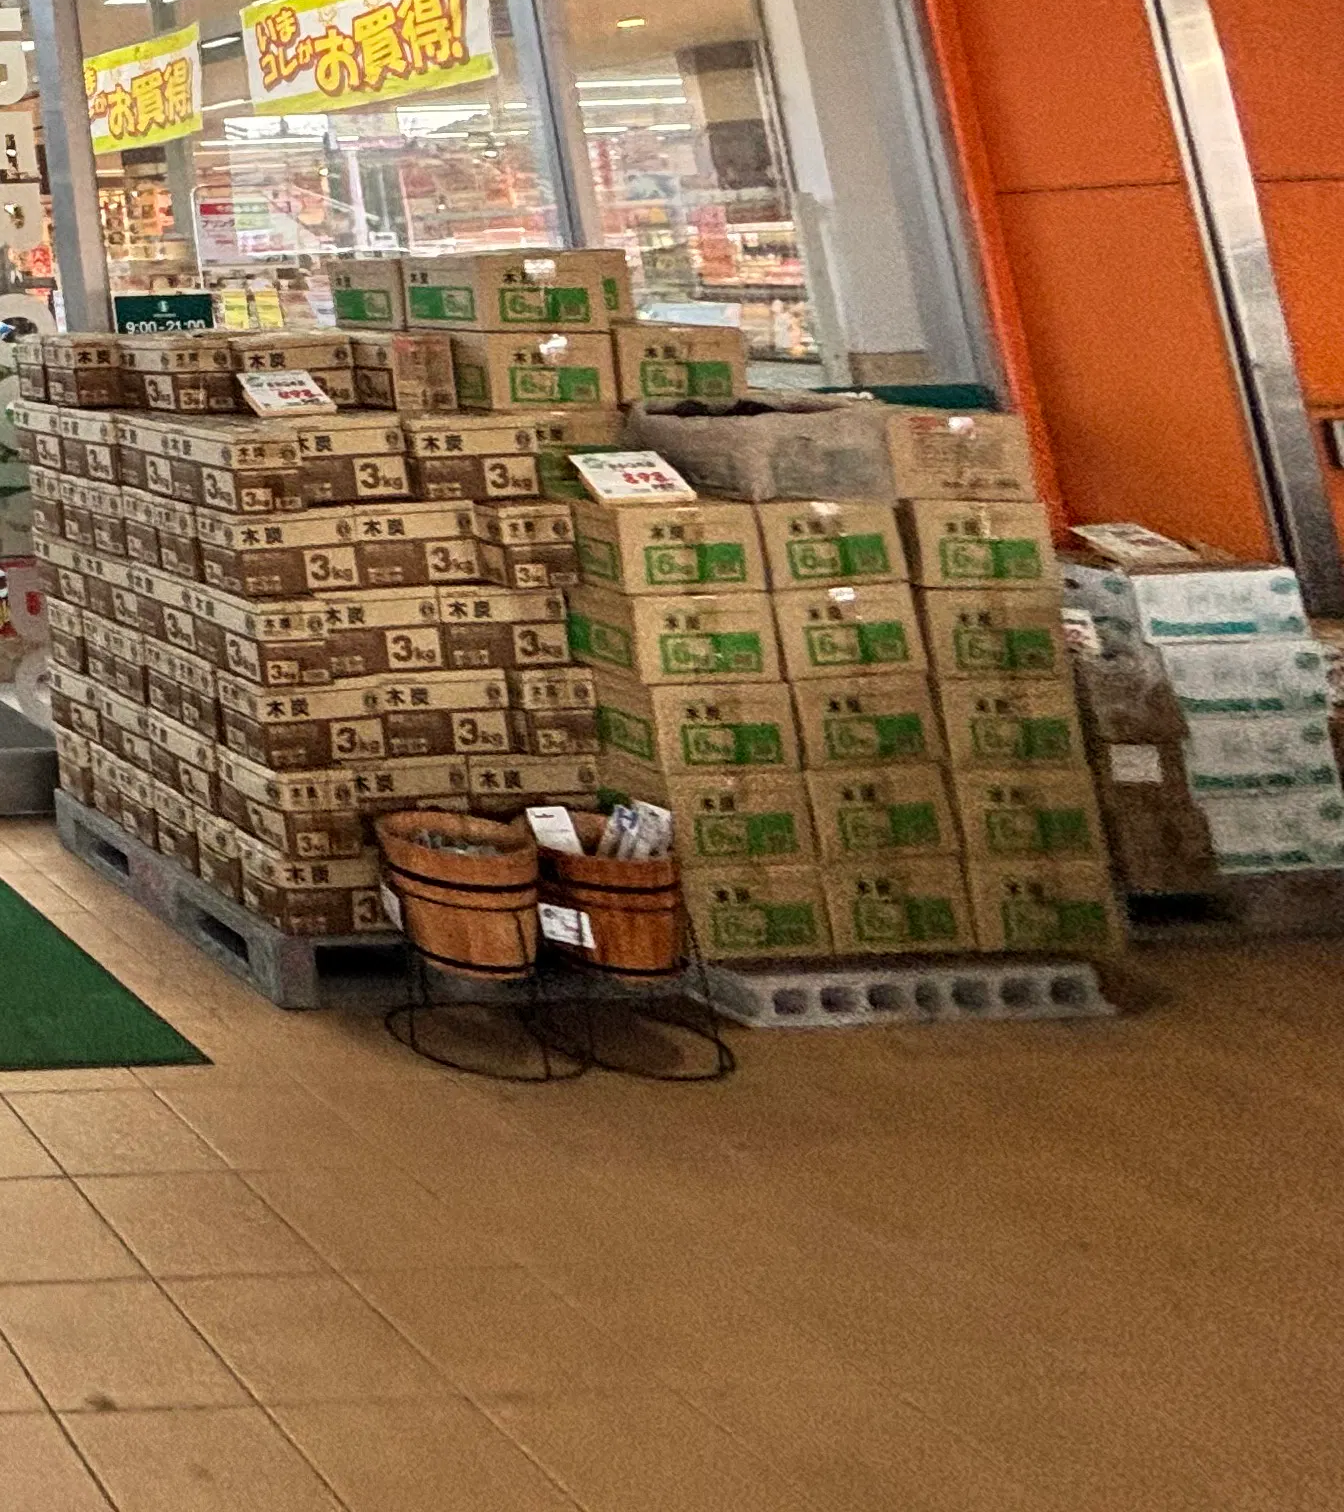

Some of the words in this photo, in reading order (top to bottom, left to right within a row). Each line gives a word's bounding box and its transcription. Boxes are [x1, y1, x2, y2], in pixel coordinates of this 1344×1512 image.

[78, 350, 111, 364] 木炭
[249, 352, 286, 368] 木炭
[423, 435, 463, 451] 木炭
[359, 462, 404, 489] 3kg
[488, 463, 533, 491] 3kg
[240, 527, 282, 545] 木炭
[364, 519, 405, 535] 木炭
[310, 553, 352, 582] 3kg
[431, 546, 474, 575] 3kg
[325, 606, 365, 624] 木炭
[448, 601, 491, 619] 木炭
[392, 635, 437, 663] 3kg
[517, 630, 562, 658] 3kg
[386, 688, 430, 706] 木炭
[266, 697, 310, 717] 木炭
[336, 727, 380, 754] 3kg
[458, 718, 503, 746] 3kg
[355, 774, 394, 792] 木炭
[480, 770, 522, 789] 木炭
[287, 866, 329, 885] 木炭
